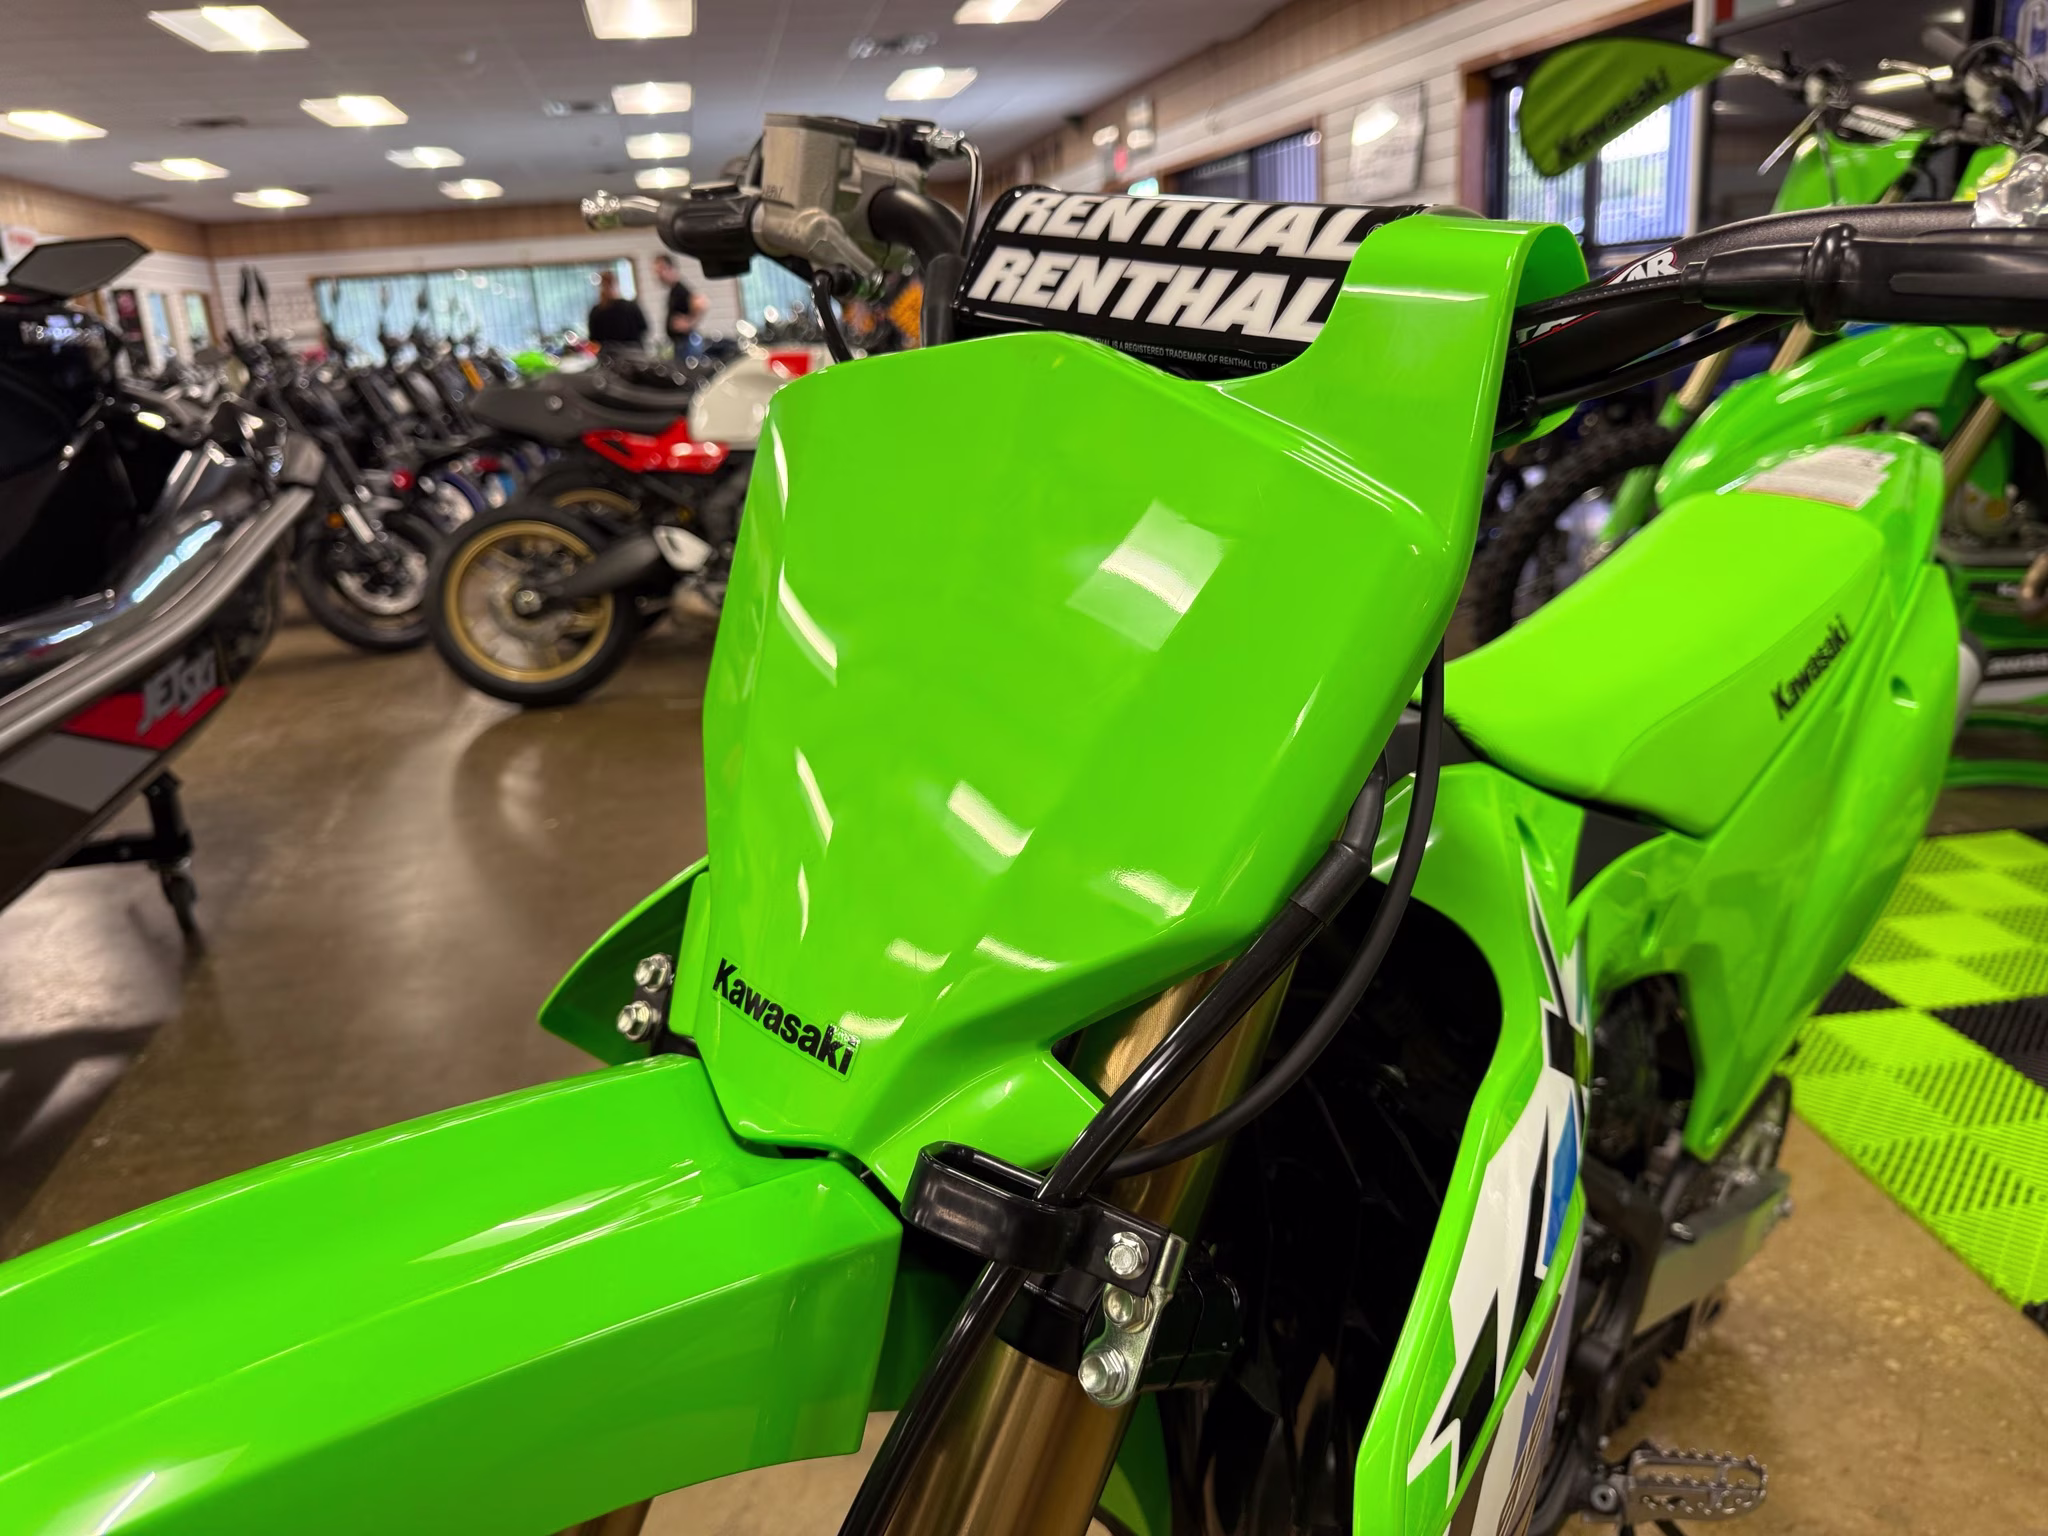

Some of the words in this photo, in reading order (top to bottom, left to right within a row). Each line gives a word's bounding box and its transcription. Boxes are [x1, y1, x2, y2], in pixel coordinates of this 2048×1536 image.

[995, 191, 1374, 262] RENTHAL
[967, 246, 1336, 343] RENTHAL
[1124, 342, 1165, 357] REGISTERED
[1165, 348, 1207, 363] TRADEMARK
[1207, 354, 1219, 364] OF
[1219, 356, 1252, 369] RENTHAL
[1770, 613, 1850, 720] Kawasaki
[712, 957, 858, 1075] Kawasaki
